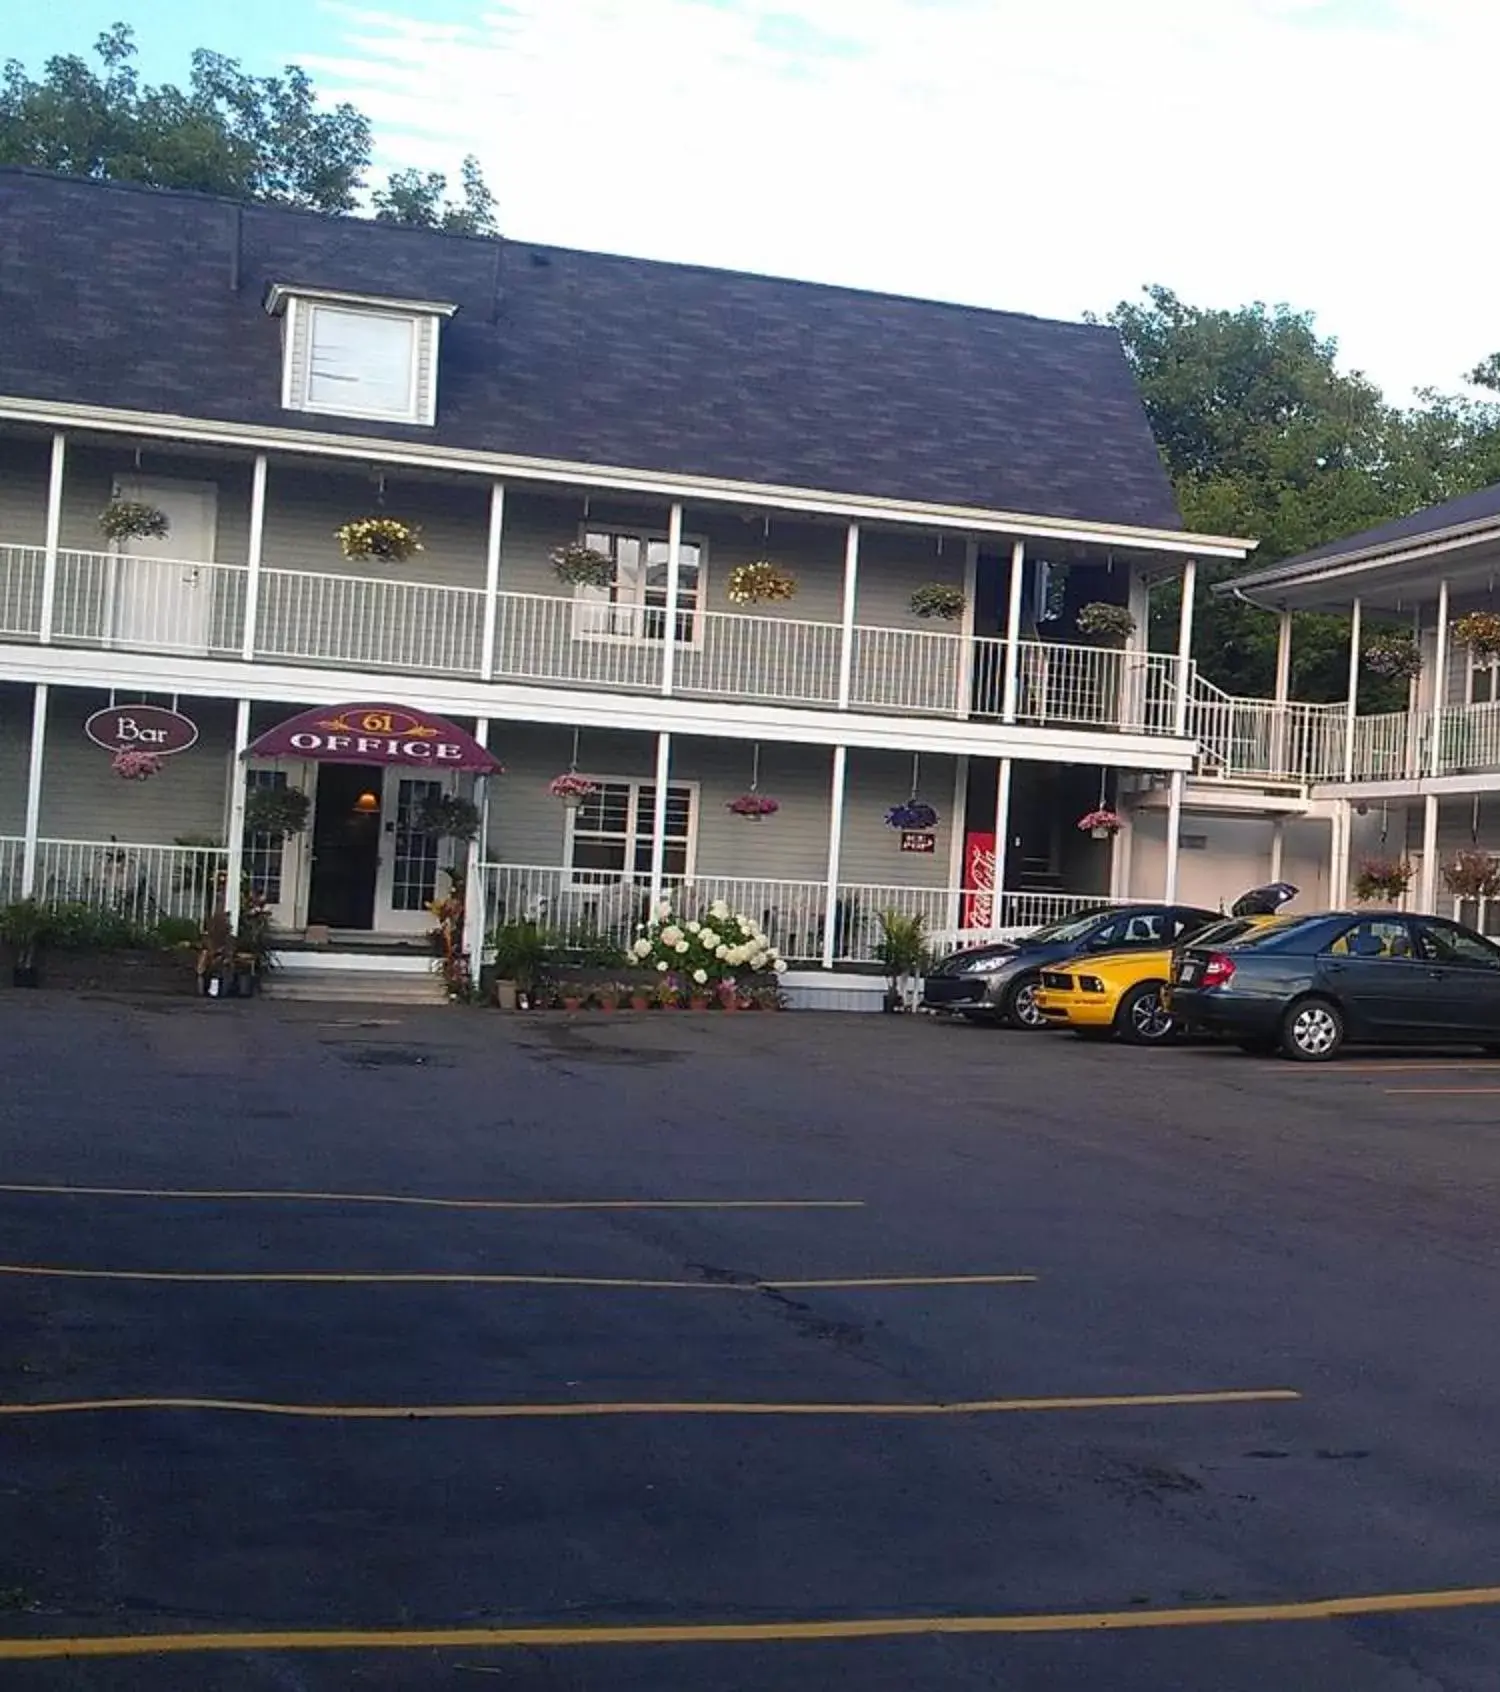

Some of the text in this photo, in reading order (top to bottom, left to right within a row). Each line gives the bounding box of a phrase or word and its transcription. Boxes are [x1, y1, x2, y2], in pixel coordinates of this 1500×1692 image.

[116, 717, 168, 743] Bar
[362, 713, 393, 732] 61
[290, 733, 463, 759] OFFICE
[969, 844, 995, 929] CocaCola
